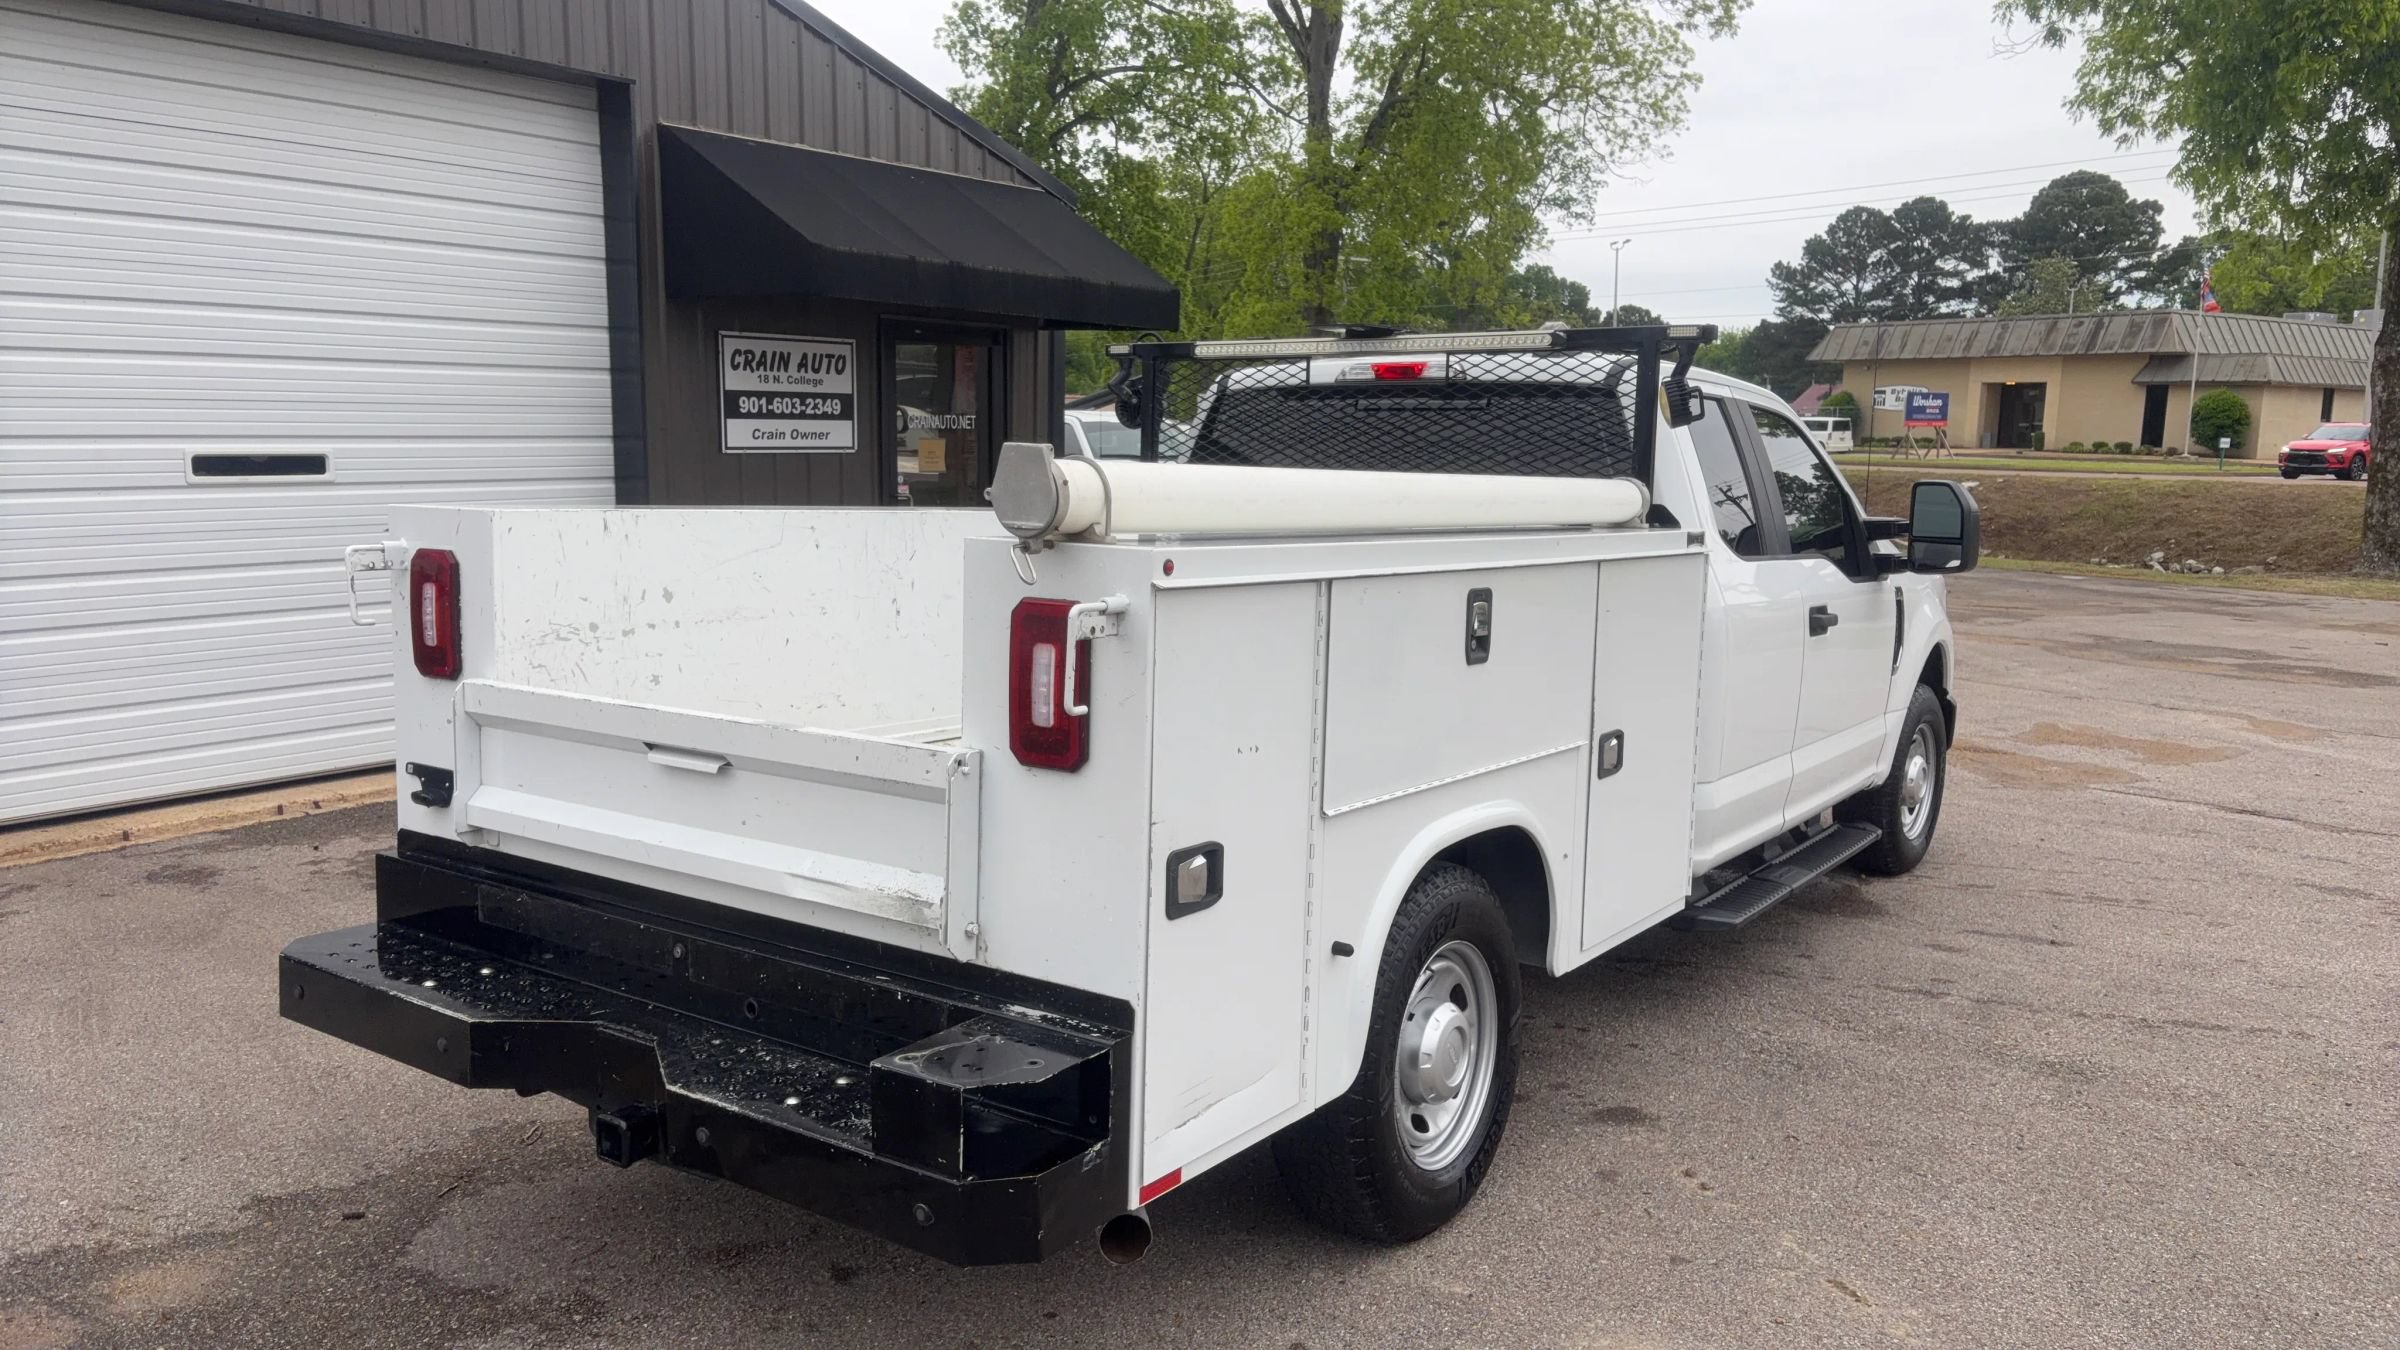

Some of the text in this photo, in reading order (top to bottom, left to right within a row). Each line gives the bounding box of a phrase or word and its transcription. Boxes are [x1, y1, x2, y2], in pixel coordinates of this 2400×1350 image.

[730, 348, 847, 375] CRAIN AUTO
[757, 374, 824, 387] 18 N. College
[739, 396, 841, 415] 901-603-2349
[907, 414, 976, 430] CRAINAUTO.NET
[752, 428, 830, 440] Crain Owner
